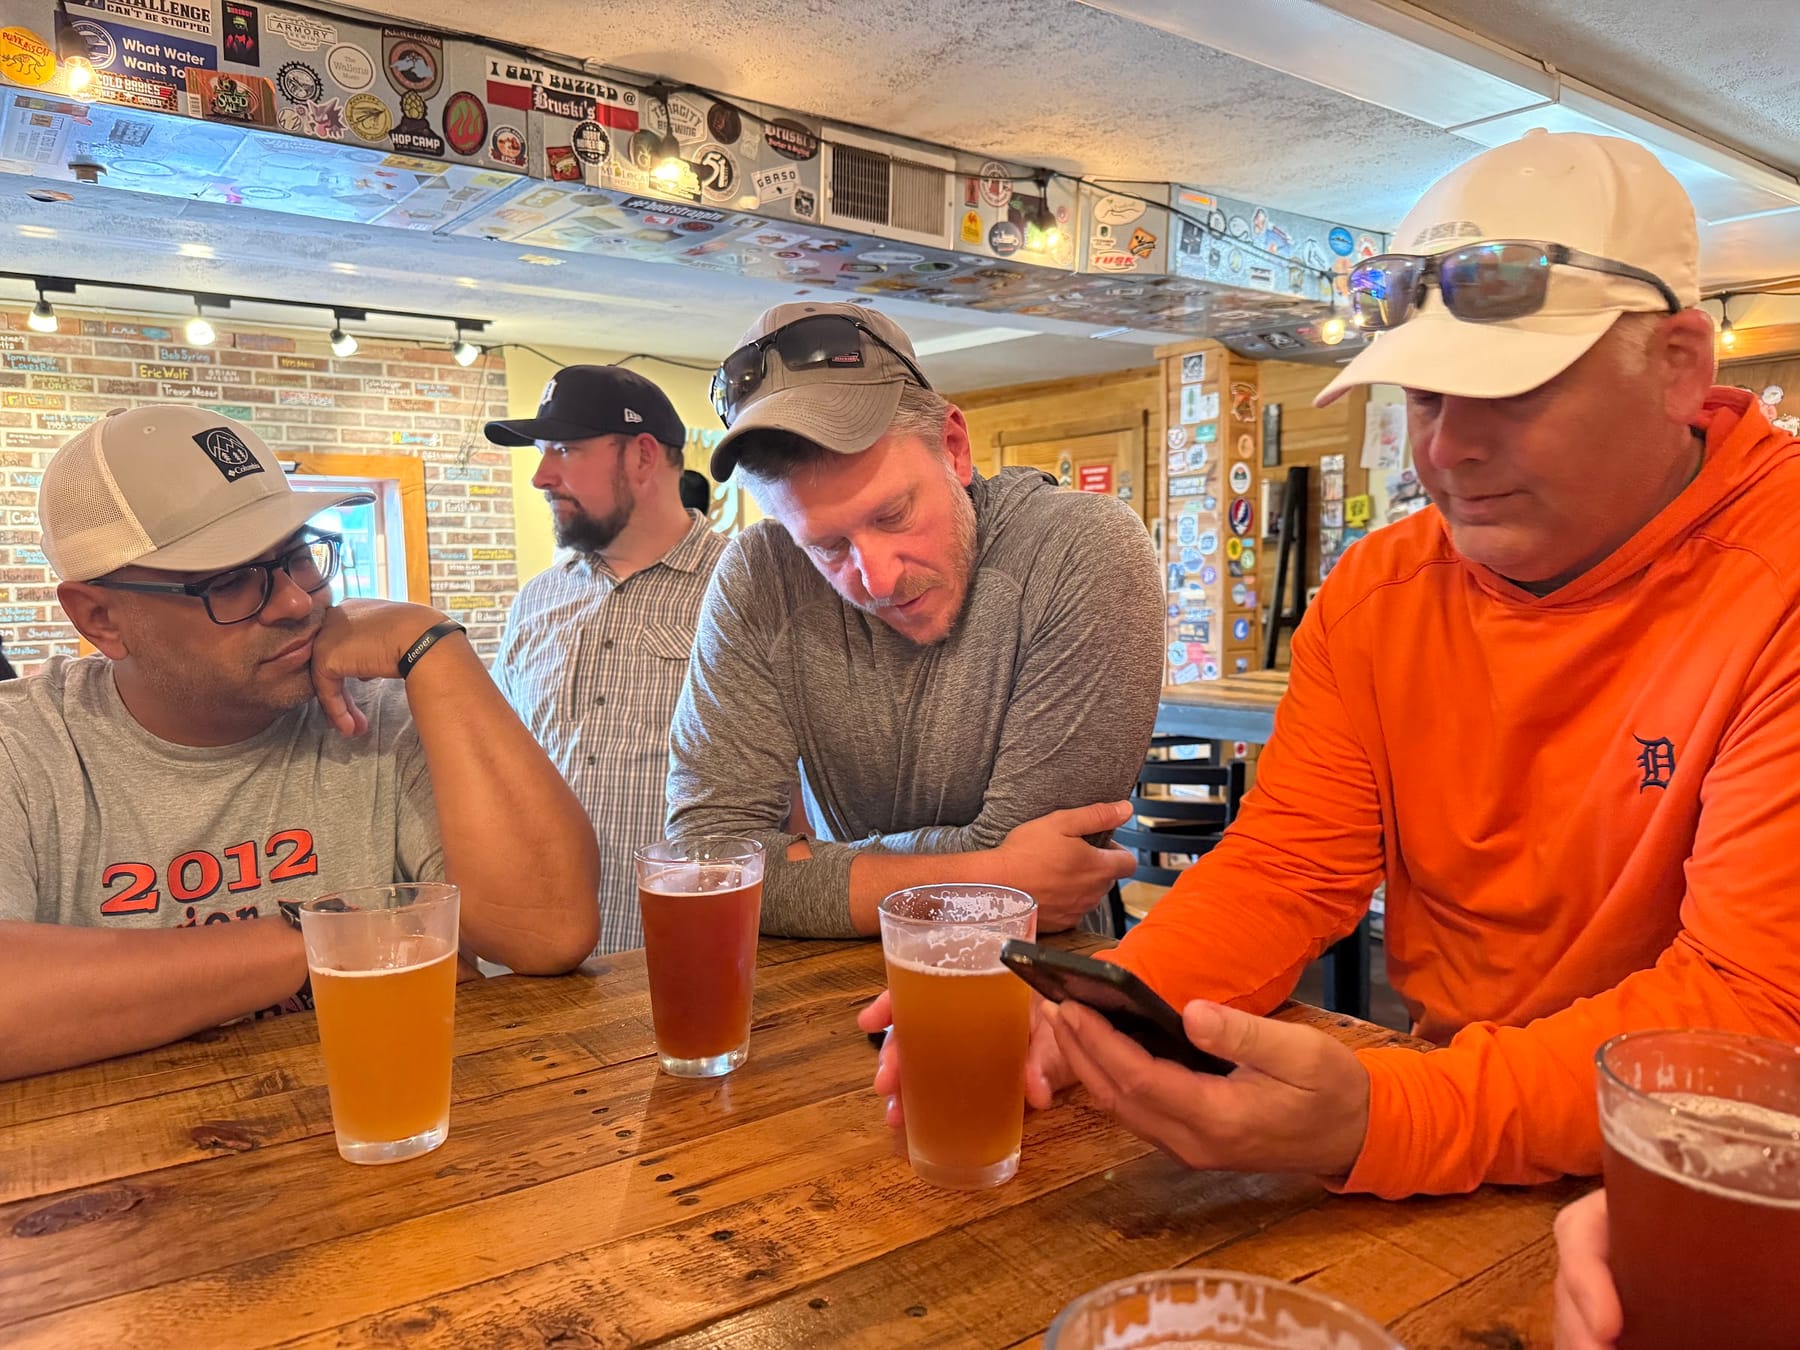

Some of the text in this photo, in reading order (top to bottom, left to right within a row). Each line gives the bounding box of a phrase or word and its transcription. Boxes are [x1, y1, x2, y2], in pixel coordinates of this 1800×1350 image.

[107, 0, 210, 22] ALLENGE
[107, 4, 210, 33] CAN'T BE STOPPED
[276, 22, 329, 39] ARMORY
[122, 37, 205, 65] What Water
[122, 55, 186, 79] Wants To
[491, 62, 499, 76] I
[506, 65, 544, 84] GOT
[549, 74, 618, 101] BUZZED
[534, 85, 596, 120] Bruski's
[657, 120, 697, 137] BRWING
[391, 133, 411, 146] HOP
[413, 135, 441, 150] CAMP
[160, 348, 179, 360] Bob
[139, 364, 189, 380] Eric Wolf
[1632, 732, 1675, 794] D
[100, 828, 318, 916] 2012
